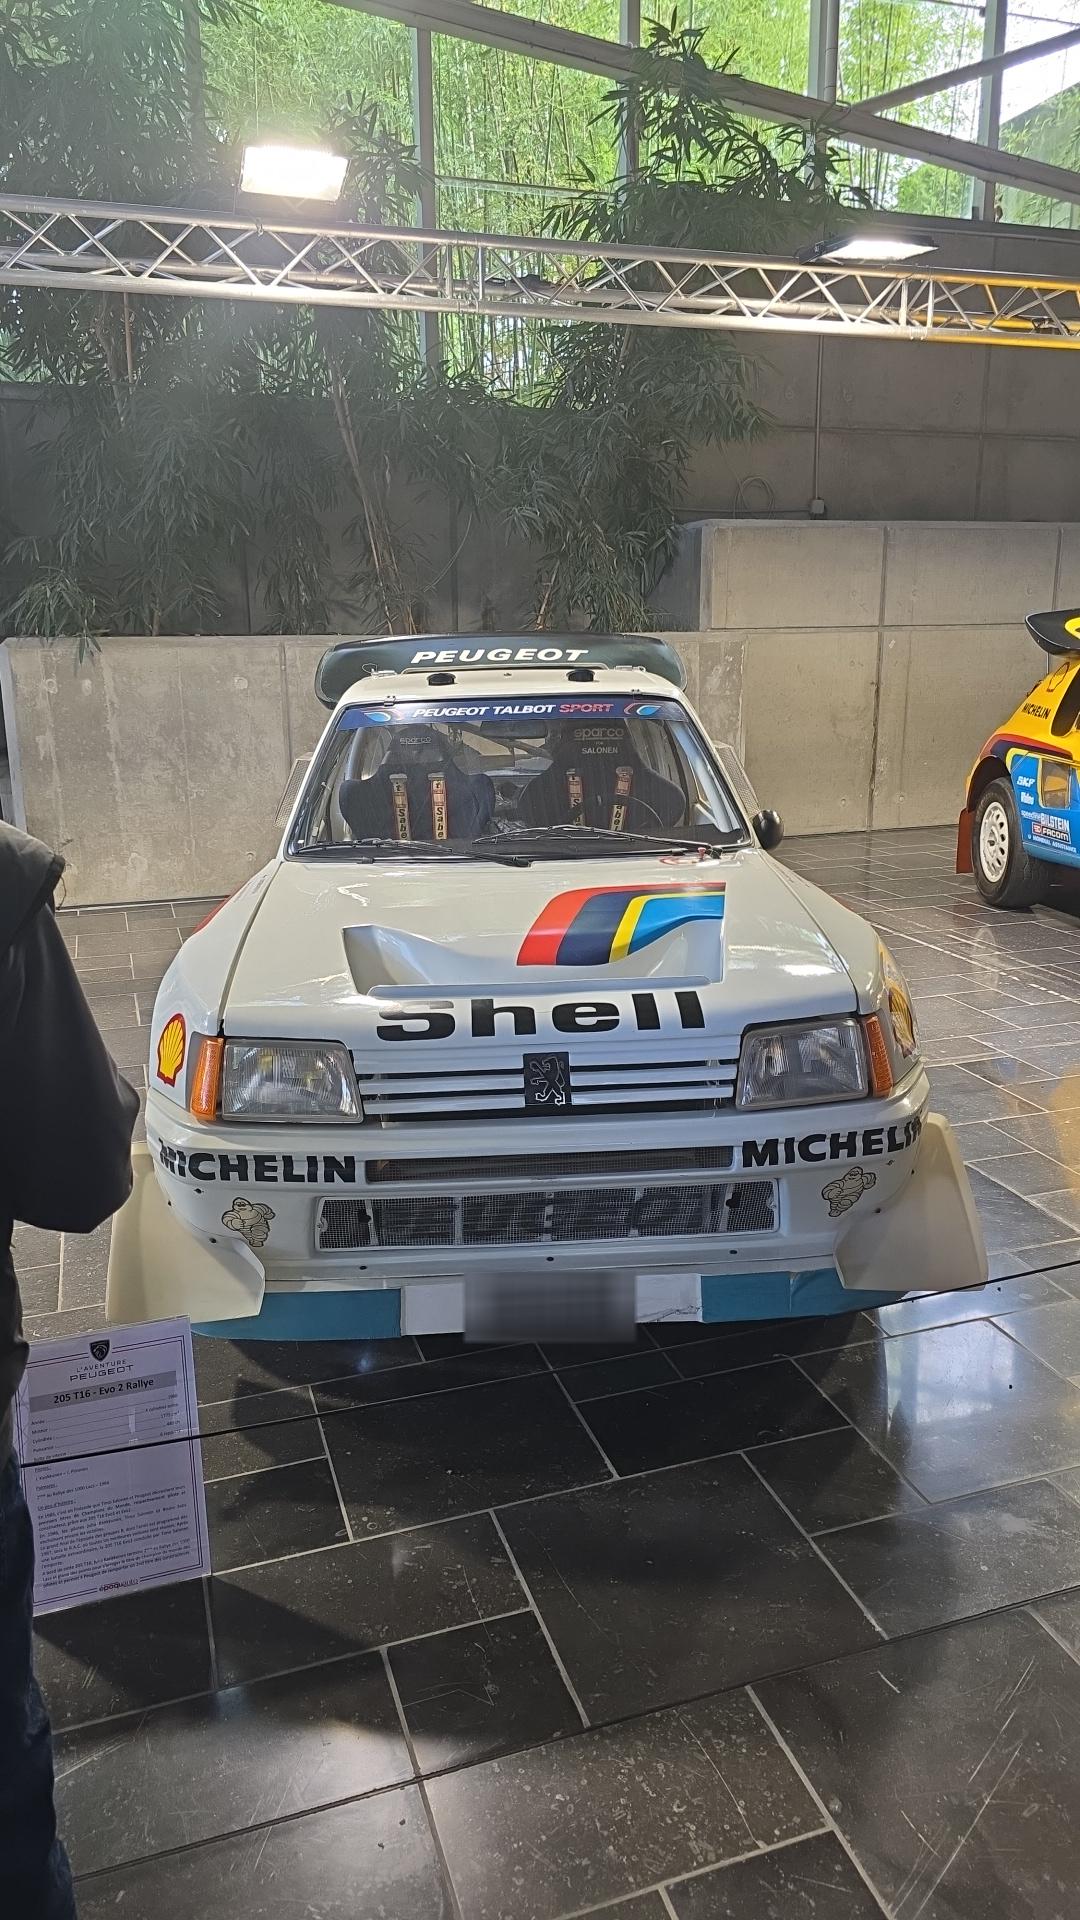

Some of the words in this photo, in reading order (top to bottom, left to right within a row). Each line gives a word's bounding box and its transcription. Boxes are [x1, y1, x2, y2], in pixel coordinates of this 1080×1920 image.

[410, 648, 589, 664] PEUGEOT
[412, 706, 490, 718] PEUGEOT
[493, 704, 557, 715] TALBOT
[559, 703, 615, 713] SPORT
[1022, 703, 1051, 719] MICHELIN
[575, 728, 624, 741] sparco
[582, 746, 618, 754] SALONEN
[1041, 813, 1070, 832] BILSTEIN
[1042, 827, 1069, 841] FACOM
[377, 990, 706, 1041] Shell
[742, 1115, 921, 1168] MICHELIN
[159, 1138, 356, 1182] MICHELIN
[69, 1364, 134, 1382] PEUGEOT
[53, 1394, 71, 1404] 205
[74, 1389, 91, 1399] T16
[99, 1386, 116, 1396] Evo
[119, 1384, 124, 1392] 2
[126, 1379, 154, 1390] Rallye
